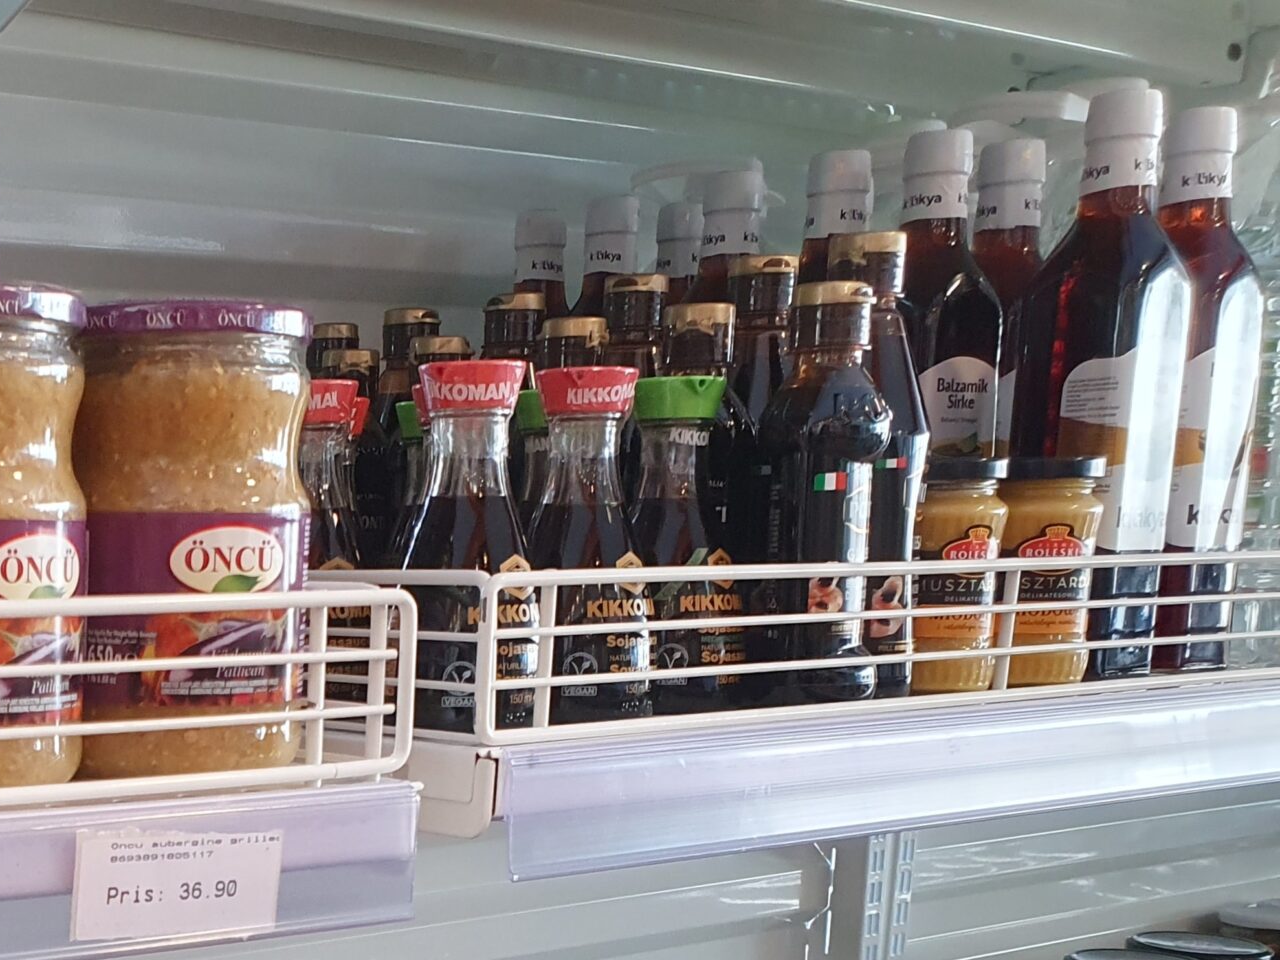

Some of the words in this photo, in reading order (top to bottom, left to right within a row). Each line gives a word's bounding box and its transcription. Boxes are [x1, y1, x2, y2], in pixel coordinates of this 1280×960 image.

[145, 310, 186, 327] ÖNCÜ
[218, 310, 256, 327] ÖNCÜ
[937, 378, 989, 393] Balzamik
[947, 394, 975, 409] Sirke
[184, 539, 276, 574] ÖNCÜ
[111, 841, 144, 850] Oncu
[106, 885, 164, 905] Pris:
[179, 879, 238, 901] 36.90
